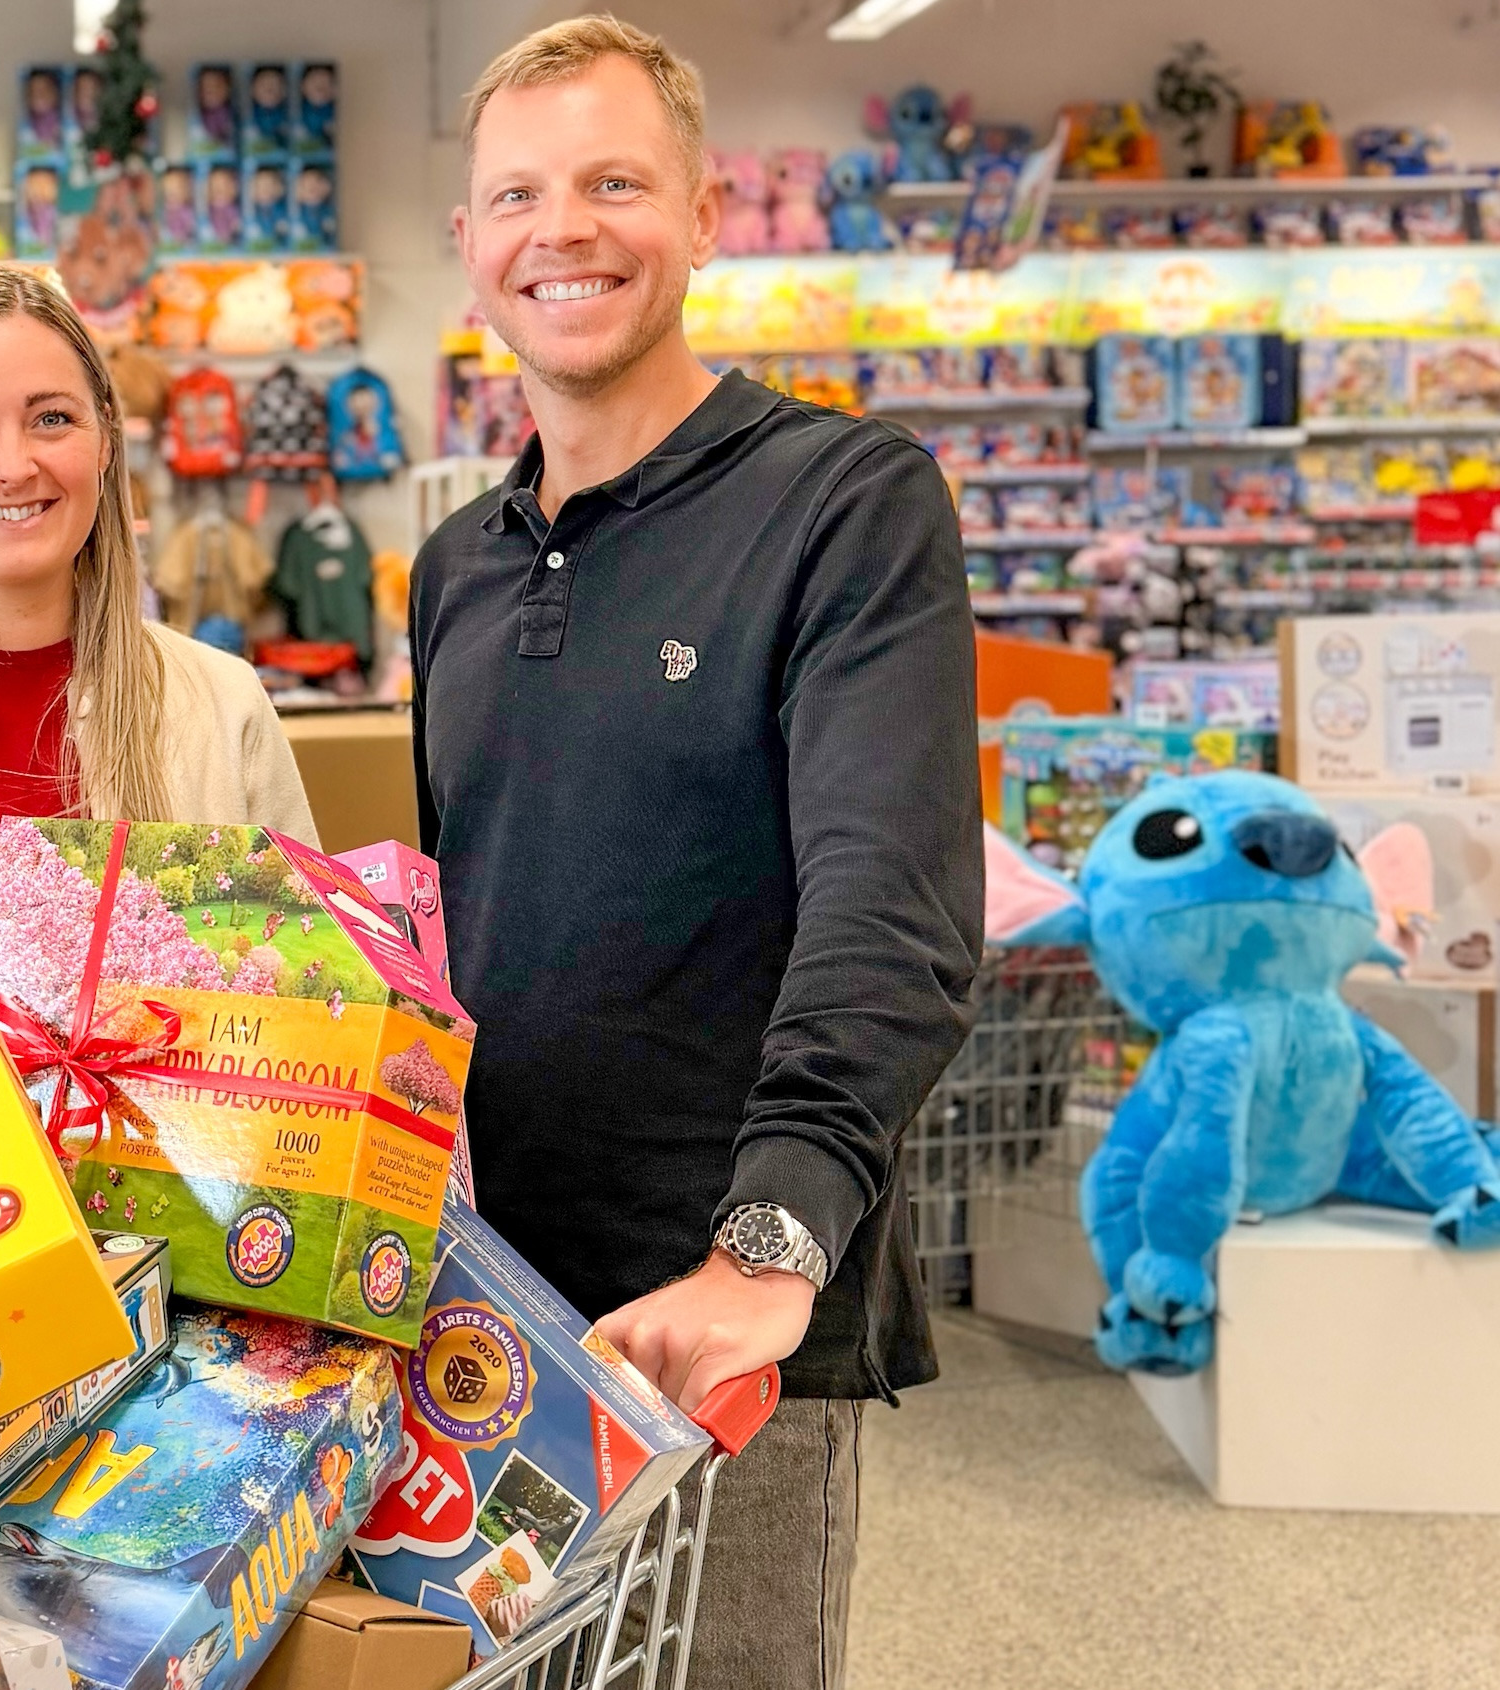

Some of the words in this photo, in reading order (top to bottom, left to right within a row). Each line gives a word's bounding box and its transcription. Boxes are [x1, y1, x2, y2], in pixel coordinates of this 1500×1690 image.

[222, 1057, 358, 1122] BLOSSOM
[275, 1129, 321, 1155] 1000
[378, 1156, 403, 1172] puzzle
[404, 1162, 431, 1181] border
[249, 1236, 273, 1263] 1000
[377, 1264, 397, 1291] 1000
[437, 1311, 481, 1332] ÅRETS
[482, 1317, 524, 1415] FAMILIESPIL
[468, 1334, 503, 1370] 2020
[46, 1396, 64, 1425] 10
[412, 1379, 472, 1436] LEGEBRANCHEN
[597, 1413, 615, 1493] FAMILIESPIL
[228, 1491, 320, 1660] AQUA
